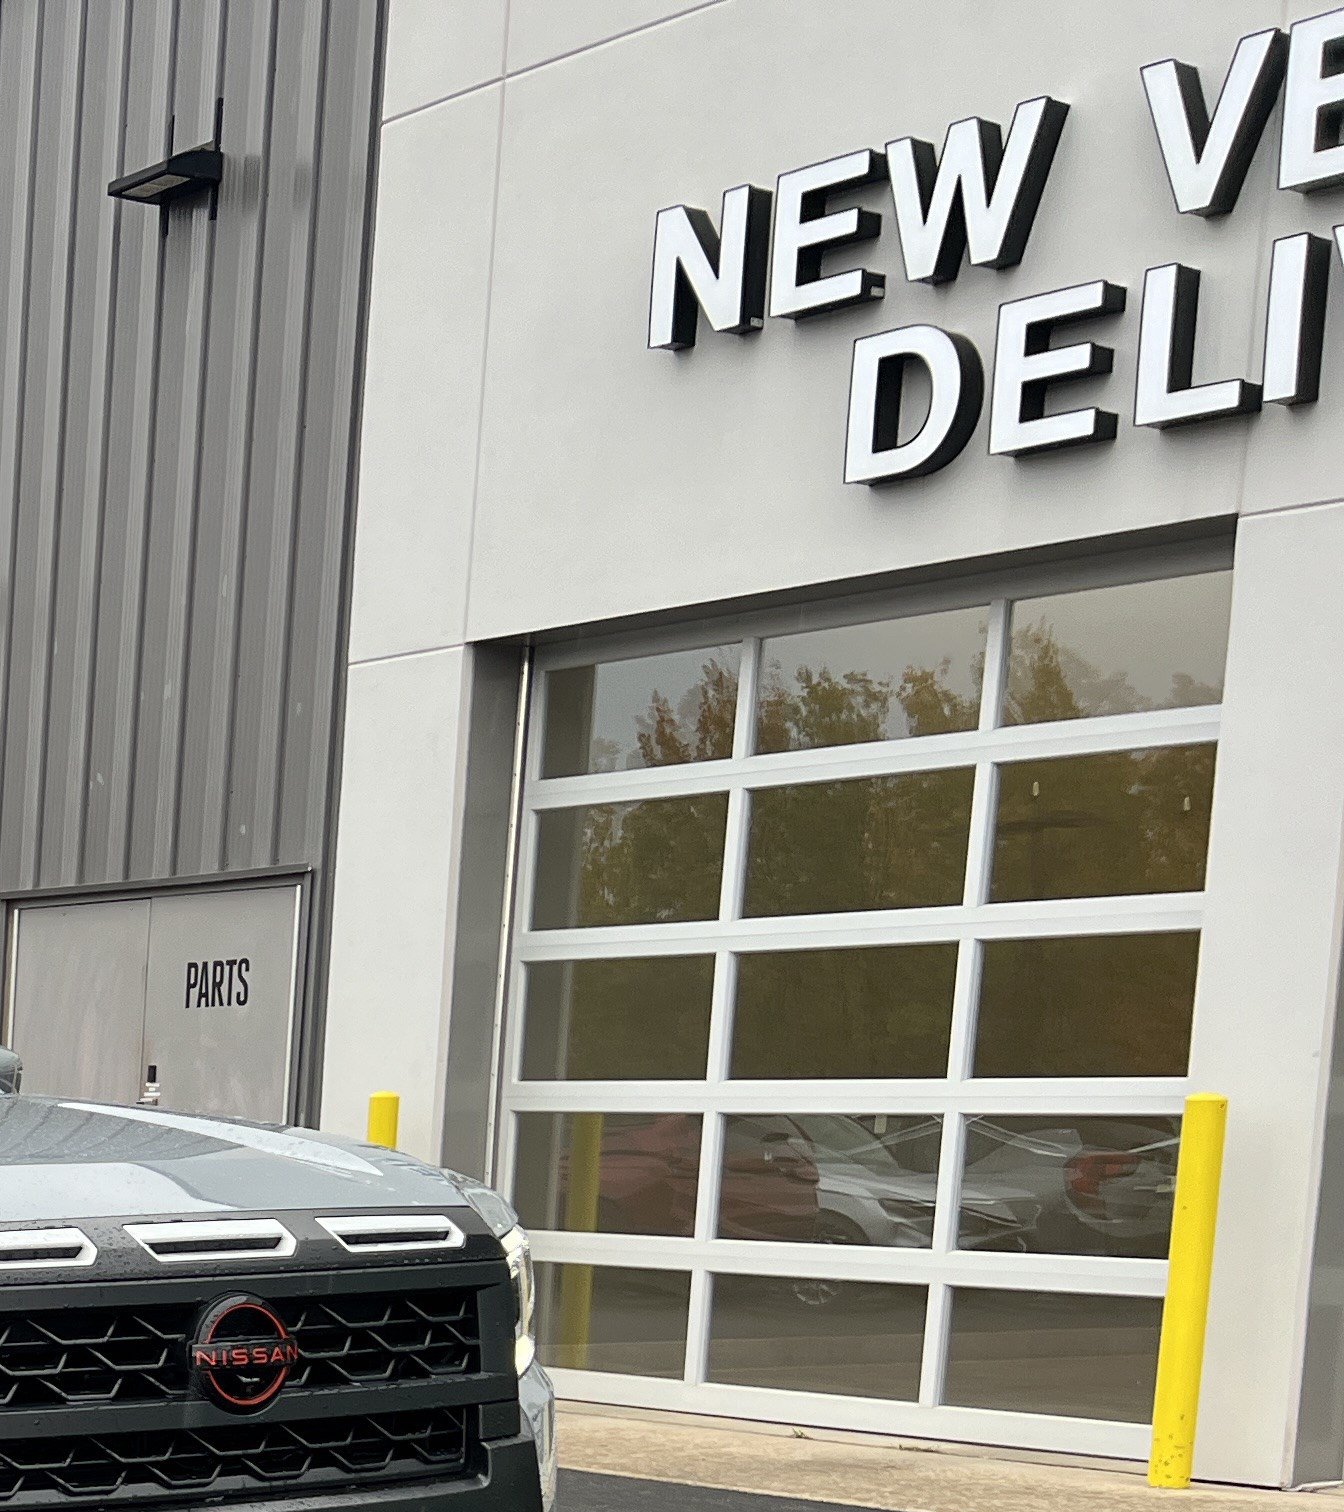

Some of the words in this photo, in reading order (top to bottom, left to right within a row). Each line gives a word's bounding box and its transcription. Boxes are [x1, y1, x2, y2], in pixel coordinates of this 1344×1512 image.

[647, 96, 1070, 351] NEW
[843, 223, 1344, 485] DELI
[185, 957, 250, 1009] PARTS
[194, 1344, 298, 1367] NISSAN
